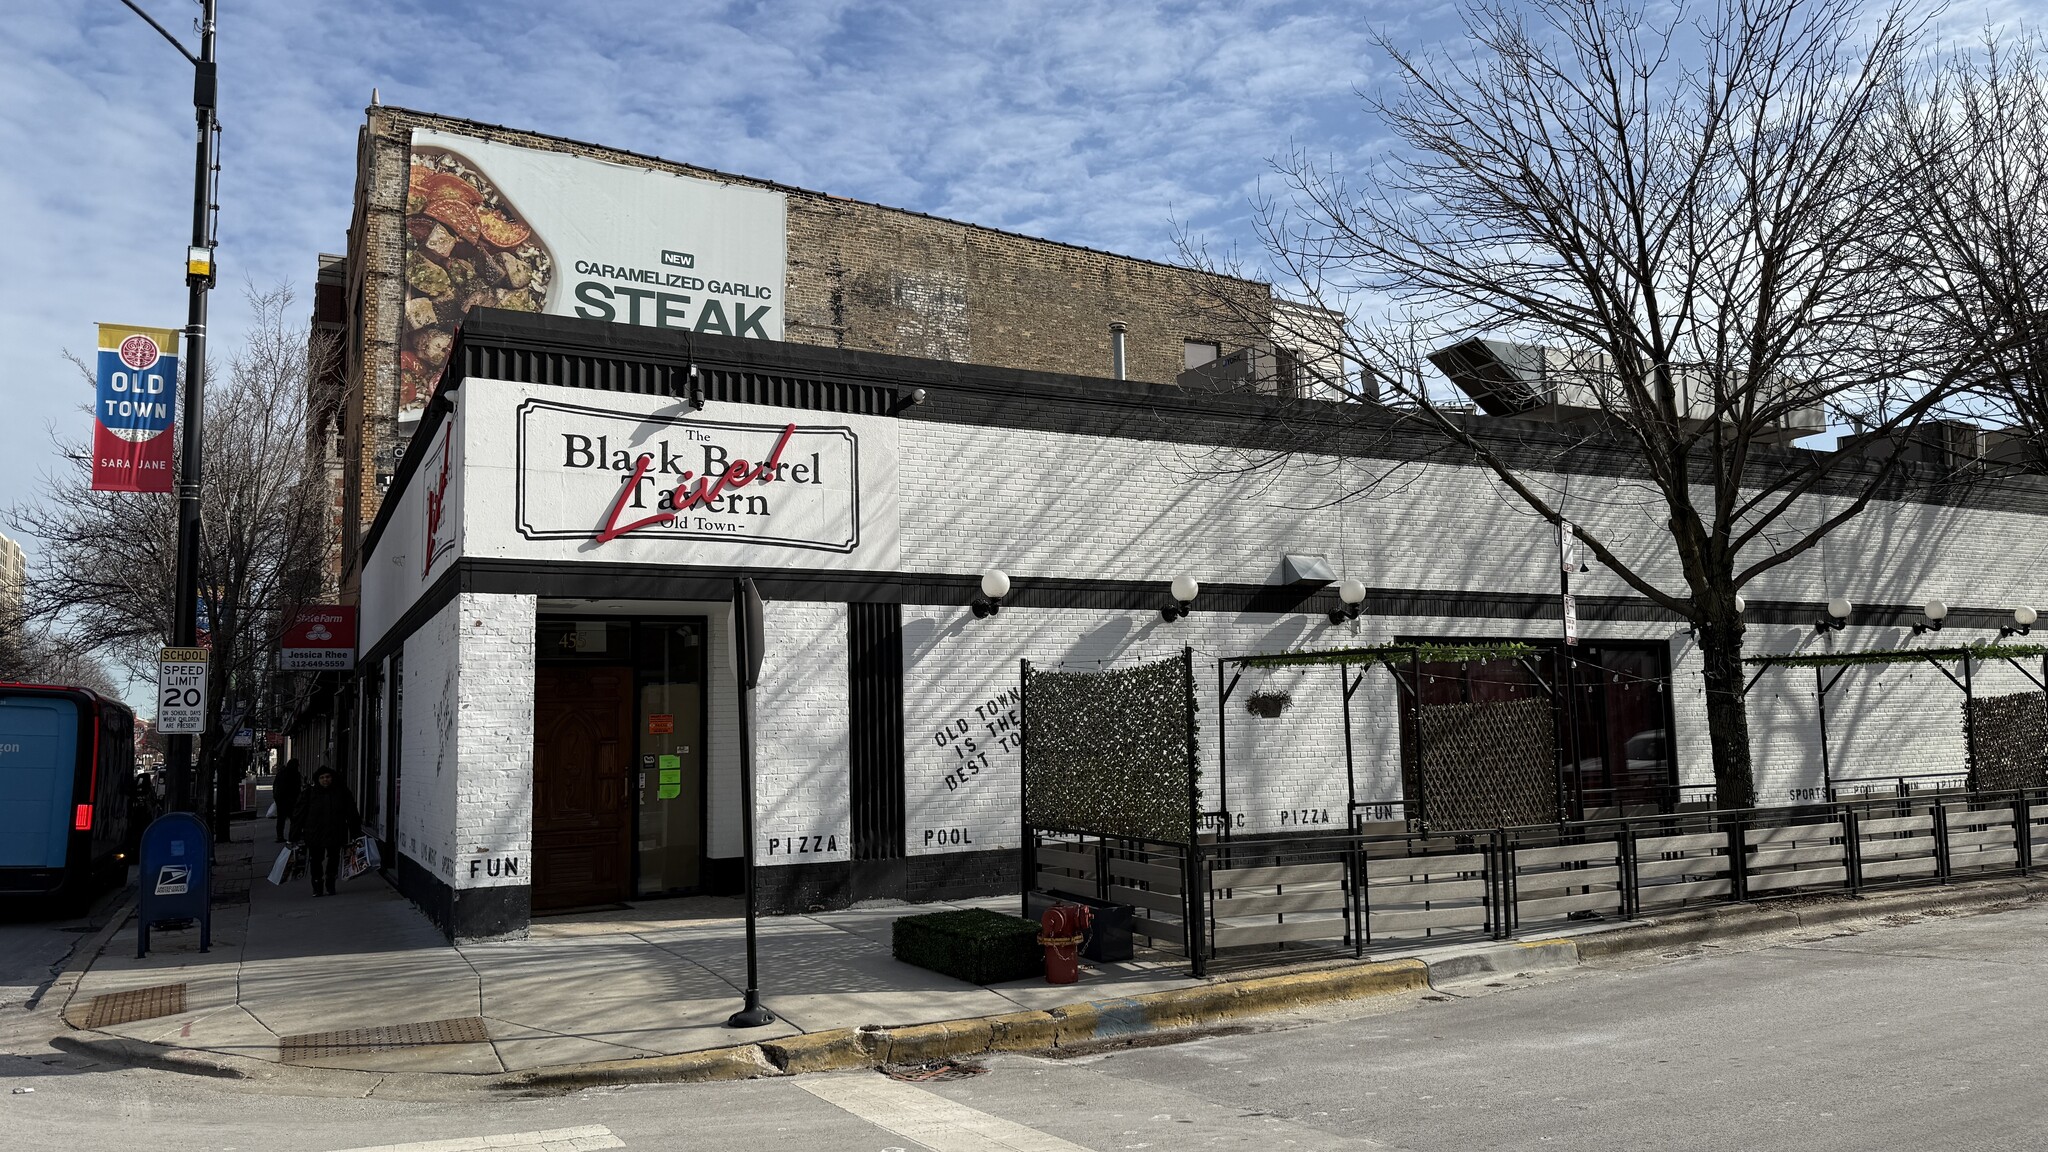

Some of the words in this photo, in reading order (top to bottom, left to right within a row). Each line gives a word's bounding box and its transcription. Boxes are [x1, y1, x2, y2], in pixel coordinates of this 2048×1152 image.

[664, 253, 692, 266] NEW
[575, 260, 705, 291] CARAMELIZED
[707, 280, 772, 300] GARLIC
[574, 281, 772, 341] STEAK
[111, 371, 164, 394] OLD
[105, 399, 167, 419] TOWN
[685, 429, 711, 442] The
[101, 458, 131, 468] SARA
[138, 460, 166, 470] JANE
[561, 433, 685, 475] Black
[700, 444, 823, 485] Barrel
[596, 423, 796, 543] Live!
[621, 474, 770, 516] Tavern
[163, 650, 205, 661] SCHOOL
[288, 650, 322, 659] Jessica
[325, 650, 348, 659] Rhee
[290, 660, 345, 668] 312-649-5559
[163, 665, 204, 675] SPEED
[167, 676, 199, 686] LIMIT
[163, 688, 202, 707] 20
[934, 718, 969, 747] OLD
[975, 687, 1021, 721] TOWN
[955, 737, 977, 760] IS
[986, 710, 1020, 738] THE
[945, 751, 989, 792] BEST
[998, 732, 1021, 753] TO
[1789, 787, 1827, 801] SPORTS
[1280, 808, 1329, 825] PIZZA
[1366, 804, 1393, 821] FUN
[769, 834, 838, 856] PIZZA
[924, 827, 972, 846] POOL
[470, 856, 518, 878] FUN
